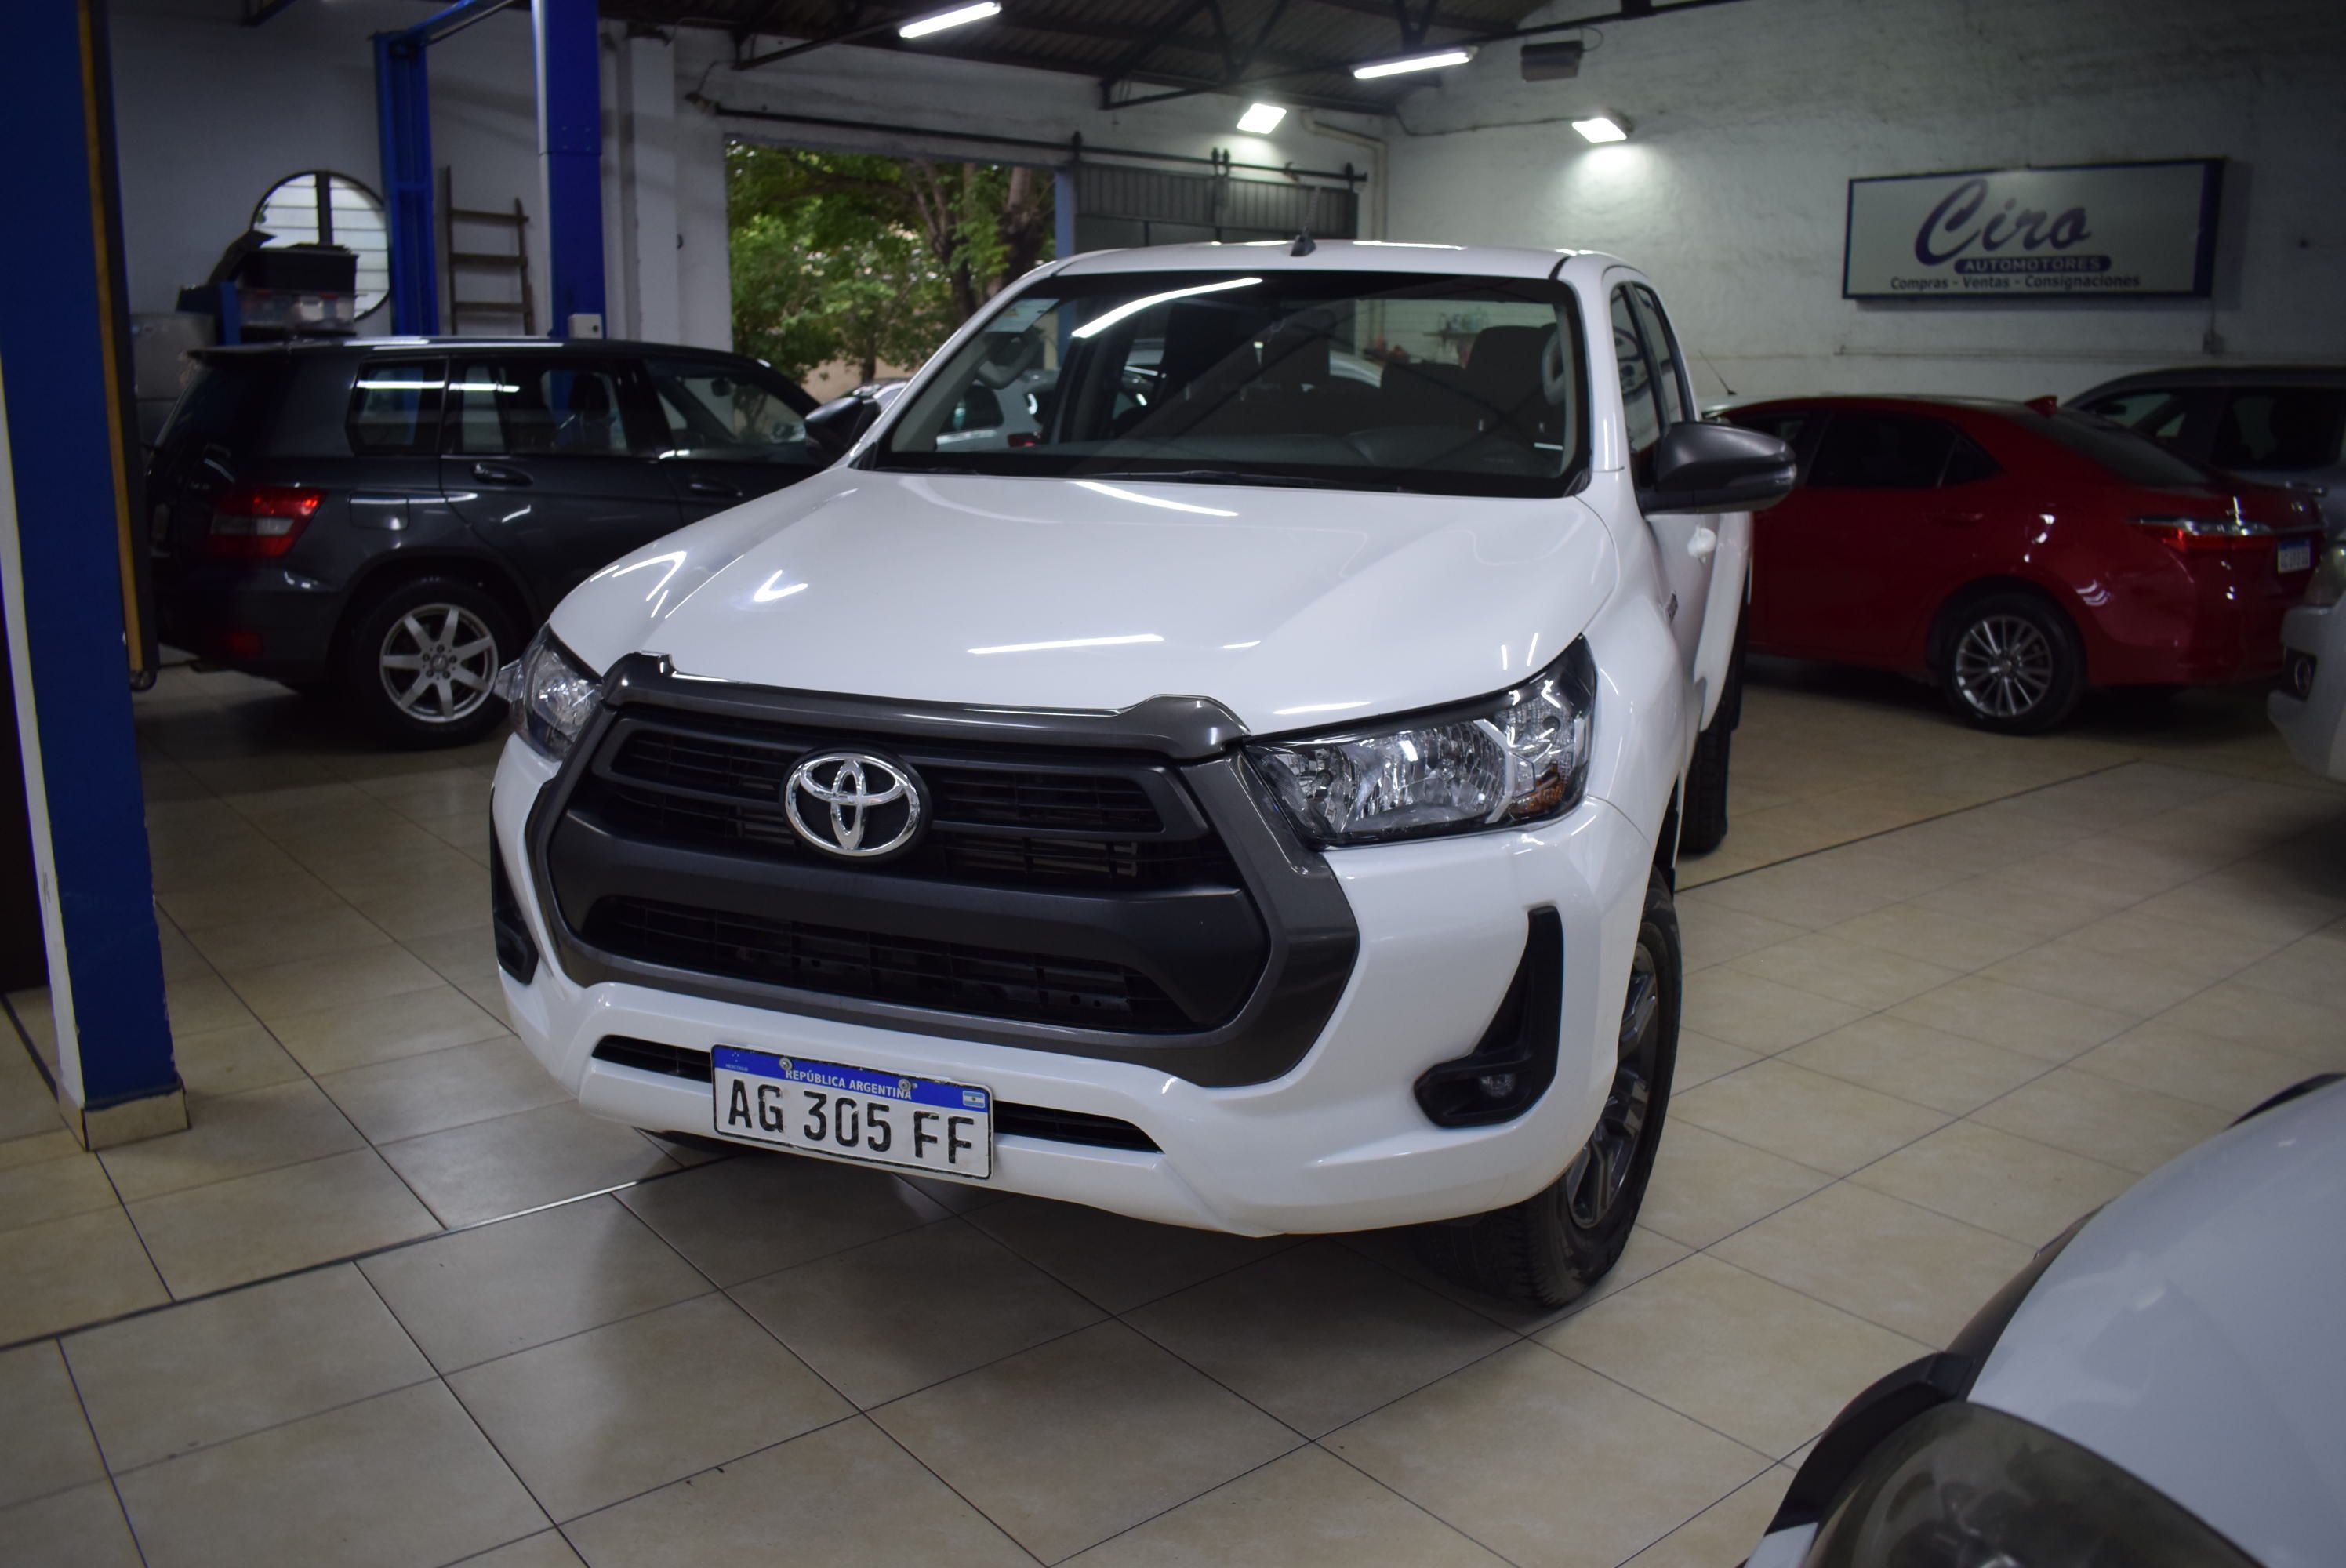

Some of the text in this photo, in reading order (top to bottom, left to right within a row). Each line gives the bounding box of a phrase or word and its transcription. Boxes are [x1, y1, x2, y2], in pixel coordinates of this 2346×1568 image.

[1915, 178, 2092, 265] Ciro
[1964, 256, 2101, 272] AUTOMOTORES
[1890, 276, 1948, 291] Compras
[1962, 274, 2010, 289] Ventas
[2025, 274, 2141, 291] Consignaciones
[785, 1069, 913, 1101] REPÚBLICA ARGENTINA
[728, 1078, 975, 1164] AG 305 FF
